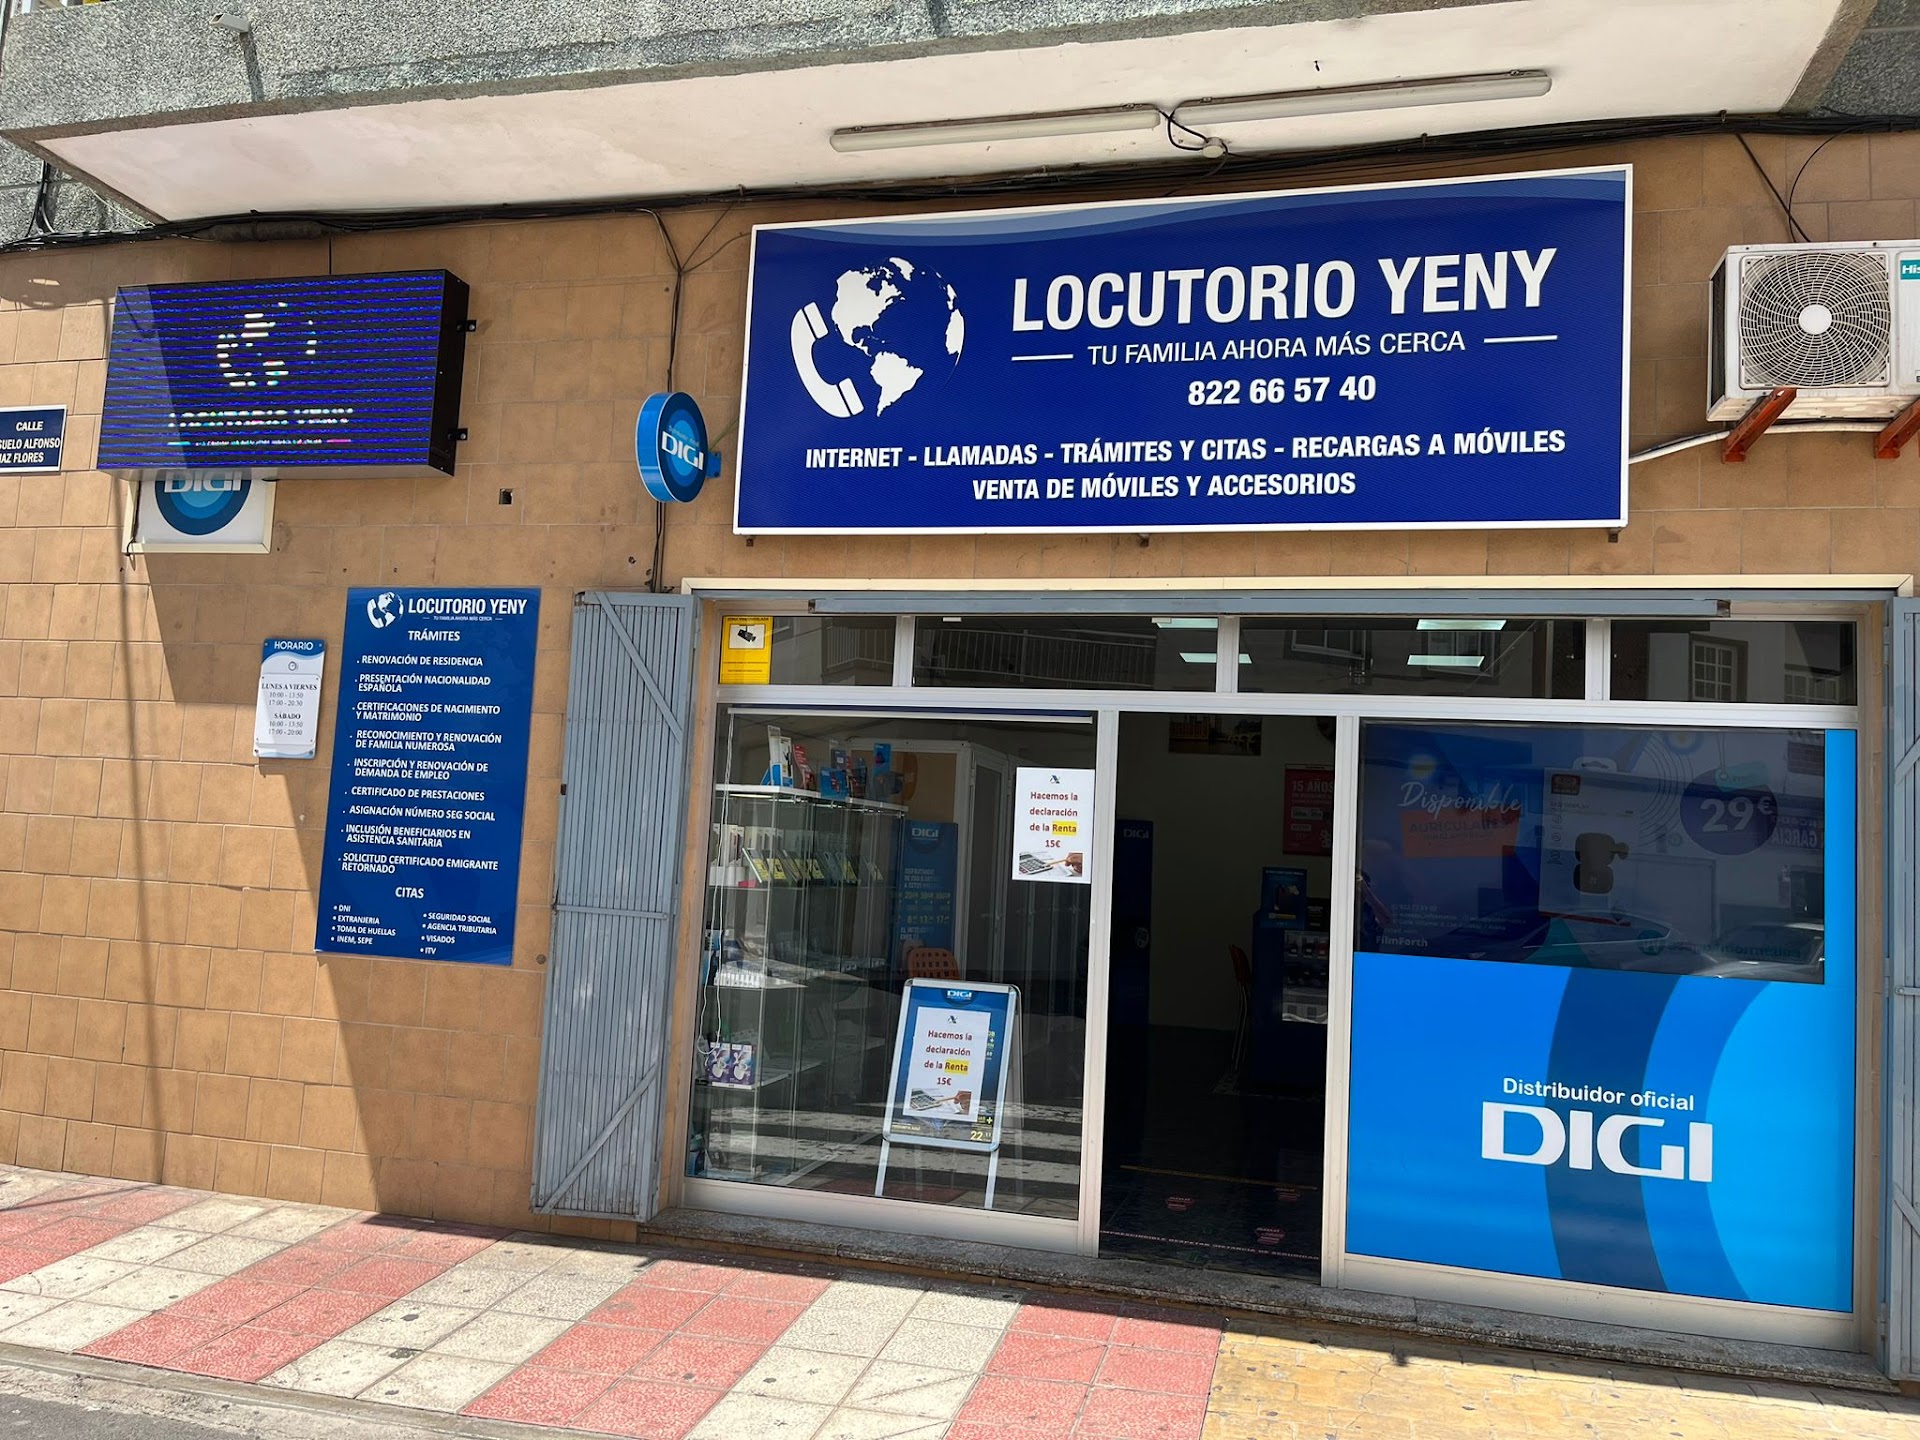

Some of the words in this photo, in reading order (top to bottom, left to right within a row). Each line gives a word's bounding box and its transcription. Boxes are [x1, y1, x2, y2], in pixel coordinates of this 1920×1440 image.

[1012, 260, 1356, 331] LOCUTORIO
[1378, 248, 1558, 315] YENY
[1087, 345, 1117, 366] TU
[1125, 342, 1217, 364] FAMILIA
[1222, 337, 1308, 361] AHORA
[1315, 331, 1371, 358] MÁS
[1380, 331, 1466, 356] CERCA
[1188, 380, 1242, 406] 822
[1248, 378, 1286, 404] 66
[1293, 376, 1332, 403] 57
[1338, 375, 1376, 402] 40
[16, 421, 44, 431] CALLE
[23, 437, 60, 449] ALFONSO
[805, 448, 902, 469] INTERNET
[923, 443, 1038, 467] LLAMADAS
[1060, 437, 1173, 464] TRÁMITES
[1179, 440, 1194, 461] Y
[1201, 437, 1267, 460] CITAS
[1292, 434, 1420, 459] RECARGAS
[1428, 433, 1445, 455] A
[1453, 427, 1566, 455] MÓVILES
[661, 430, 704, 470] DIGI
[13, 452, 44, 463] FLORES
[164, 471, 242, 493] DIGI
[973, 478, 1040, 500] VENTA
[1046, 478, 1074, 499] DE
[1081, 472, 1179, 498] MÓVILES
[1186, 477, 1202, 496] Y
[1207, 472, 1356, 497] ACCESORIOS
[408, 598, 487, 615] LOCUTORIO
[490, 599, 527, 615] YENY
[408, 627, 460, 642] TRÁMITES
[274, 641, 314, 651] HORARIO
[361, 653, 418, 666] RENOVACIÓN
[420, 656, 431, 665] DE
[433, 656, 483, 667] RESIDENCIA
[359, 673, 422, 685] PRESENTACIÓN
[424, 675, 491, 686] NACIONALIDAD
[358, 681, 402, 693] ESPAÑOLA
[357, 702, 430, 713] CERTIFICACIONES
[431, 703, 442, 713] DE
[444, 704, 501, 715] NACIMIENTO
[356, 711, 363, 721] Y
[363, 711, 422, 723] MATRIMONIO
[356, 730, 434, 742] RECONOCIMIENTO
[435, 732, 442, 742] Y
[443, 730, 502, 744] RENOVACIÓN
[355, 739, 366, 749] DE
[368, 740, 404, 750] FAMILIA
[405, 741, 455, 752] NUMEROSA
[354, 756, 408, 769] INSCRIPCIÓN
[409, 760, 416, 769] Y
[416, 758, 475, 772] RENOVACIÓN
[477, 762, 489, 772] DE
[354, 767, 399, 778] DEMANDA
[401, 769, 413, 779] DE
[414, 770, 450, 780] EMPLEO
[351, 786, 406, 798] CERTIFICADO
[408, 789, 419, 798] DE
[421, 789, 485, 801] PRESTACIONES
[1030, 791, 1069, 801] Hacemos
[1070, 792, 1078, 801] la
[1398, 781, 1523, 818] Disponible
[349, 804, 403, 817] ASIGNACIÓN
[404, 806, 445, 819] NÚMERO
[445, 809, 464, 820] SEG
[464, 810, 496, 821] SOCIAL
[1029, 807, 1078, 817] declaración
[345, 823, 392, 835] INCLUSIÓN
[393, 826, 457, 838] BENEFICIARIOS
[458, 829, 471, 839] EN
[912, 827, 939, 837] DIGI
[1029, 823, 1040, 832] de
[1042, 823, 1050, 832] la
[1052, 824, 1077, 833] Renta
[1123, 828, 1149, 839] DIGI
[346, 834, 395, 845] ASISTENCIA
[396, 836, 443, 847] SANITARIA
[1045, 839, 1061, 848] 15€
[341, 863, 396, 874] RETORNADO
[343, 853, 388, 864] SOLICITUD
[388, 855, 445, 867] CERTIFICADO
[446, 859, 499, 871] EMIGRANTE
[395, 886, 425, 899] CITAS
[338, 904, 351, 912] DNI
[427, 912, 467, 922] SEGURIDAD
[467, 914, 491, 924] SOCIAL
[337, 925, 357, 934] TOMA
[357, 926, 367, 934] DE
[367, 926, 396, 937] HUELLAS
[427, 922, 457, 932] AGENCIA
[457, 924, 497, 935] TRIBUTARIA
[357, 936, 373, 945] SEPE
[426, 935, 456, 944] VISADOS
[424, 946, 437, 955] ITV
[947, 990, 973, 998] DIGI
[927, 1029, 963, 1040] Hacemos
[965, 1032, 973, 1041] la
[925, 1045, 971, 1057] declaración
[924, 1060, 934, 1069] de
[935, 1061, 943, 1070] la
[944, 1062, 969, 1072] Renta
[936, 1077, 952, 1086] 15€
[1503, 1077, 1625, 1105] Distribuidor
[1630, 1090, 1694, 1111] oficial
[1481, 1101, 1713, 1183] DIGI
